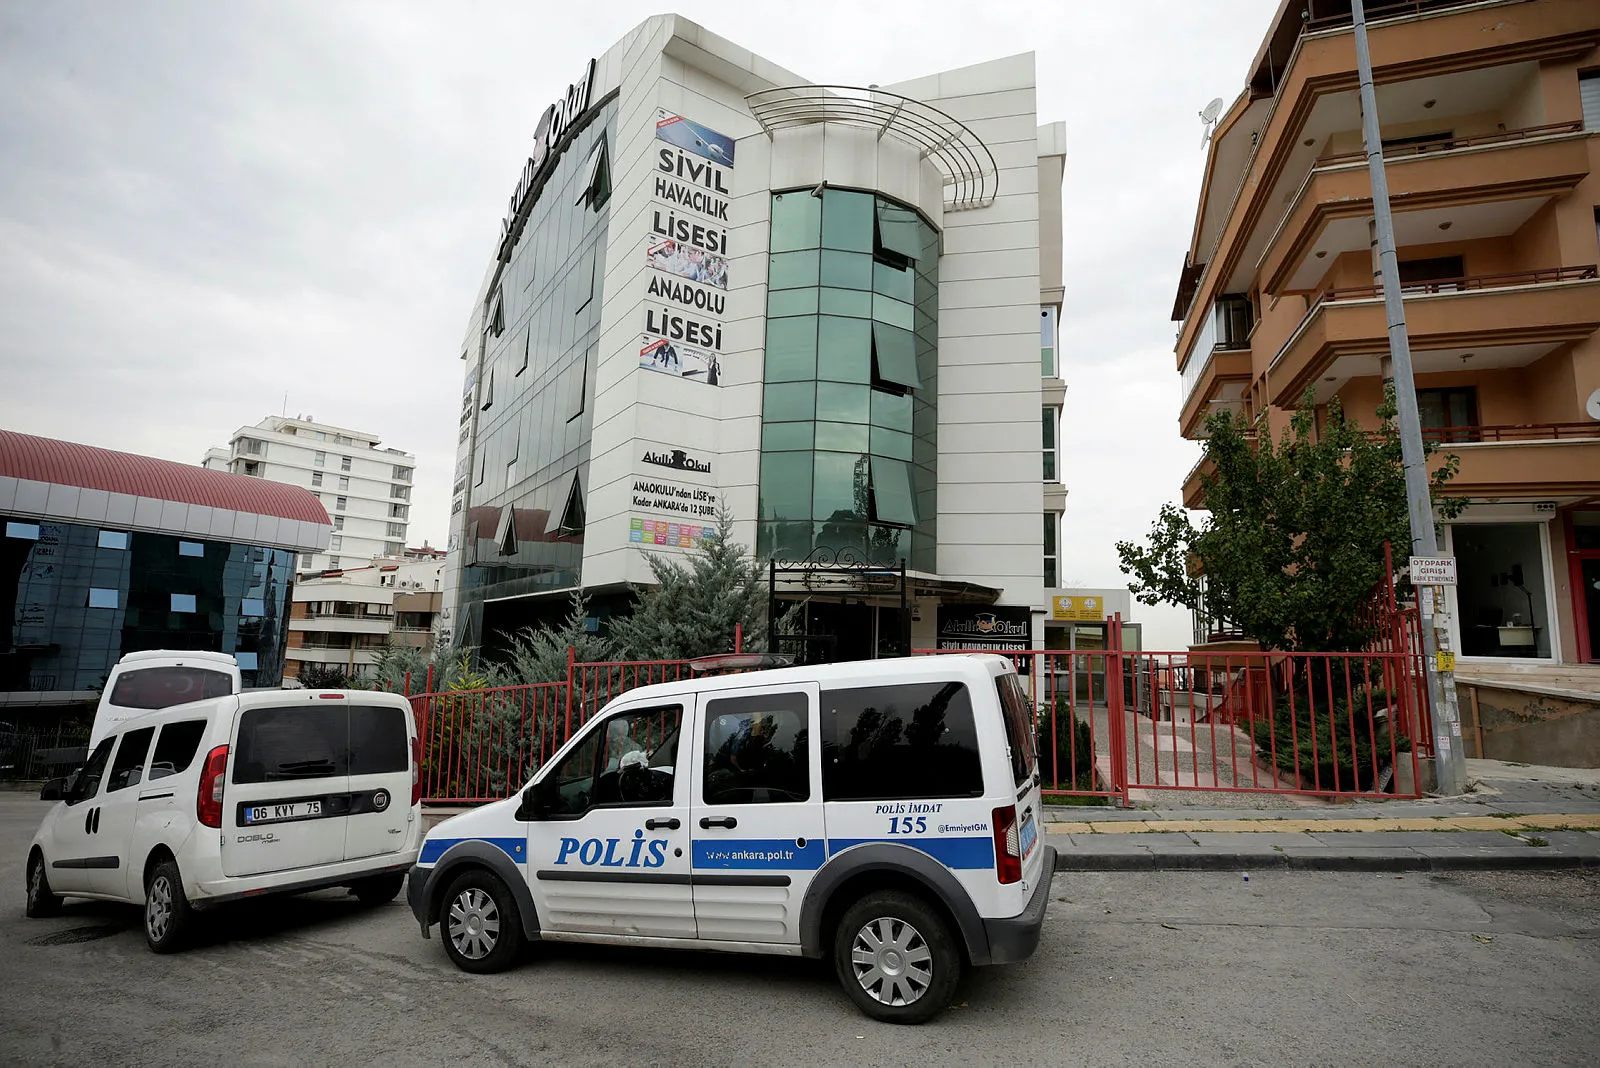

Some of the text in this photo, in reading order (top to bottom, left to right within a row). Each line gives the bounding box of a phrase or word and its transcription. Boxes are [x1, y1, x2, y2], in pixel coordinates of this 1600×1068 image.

[548, 58, 596, 149] Okul
[659, 149, 728, 194] SİVİL
[655, 177, 728, 221] HAVACILIK
[653, 211, 727, 255] LİSESİ
[648, 275, 725, 314] ANADOLU
[646, 308, 722, 350] LİSESİ
[685, 458, 711, 473] Okul
[632, 496, 714, 516] Kadar ANKARA'da 12 ŞUBE
[996, 620, 1027, 636] Okul
[253, 802, 320, 819] 06 KVY 75
[876, 803, 943, 814] POLİS İMDAT
[887, 816, 927, 834] 155
[938, 824, 988, 833] @EmniyetGM
[237, 833, 273, 843] DOBLO
[554, 829, 668, 868] POLİS
[706, 850, 794, 862] wwwankara.pol.tr
